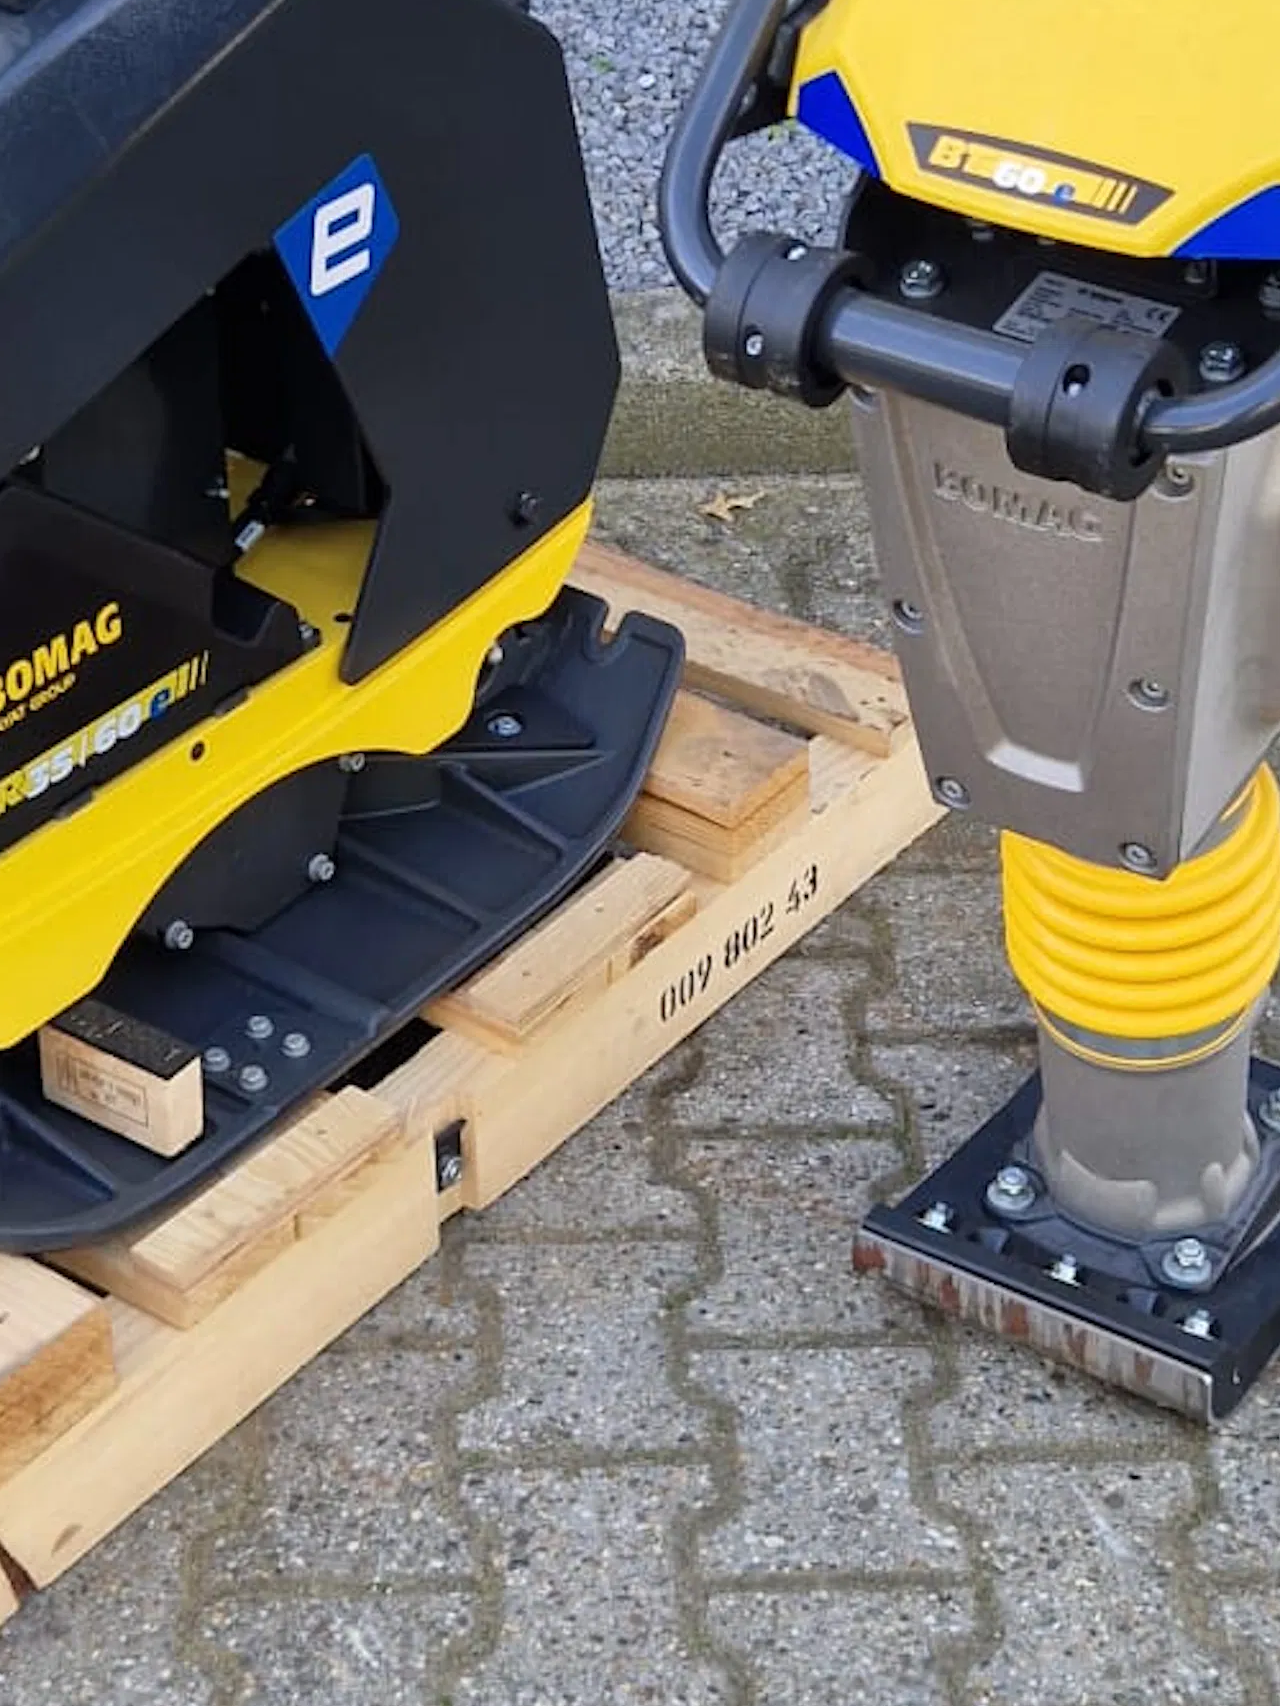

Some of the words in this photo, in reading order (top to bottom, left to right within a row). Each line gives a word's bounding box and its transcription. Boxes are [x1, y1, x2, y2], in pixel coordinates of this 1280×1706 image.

[933, 461, 1105, 545] BOMAG
[660, 953, 713, 1022] 009
[724, 901, 775, 969] 802
